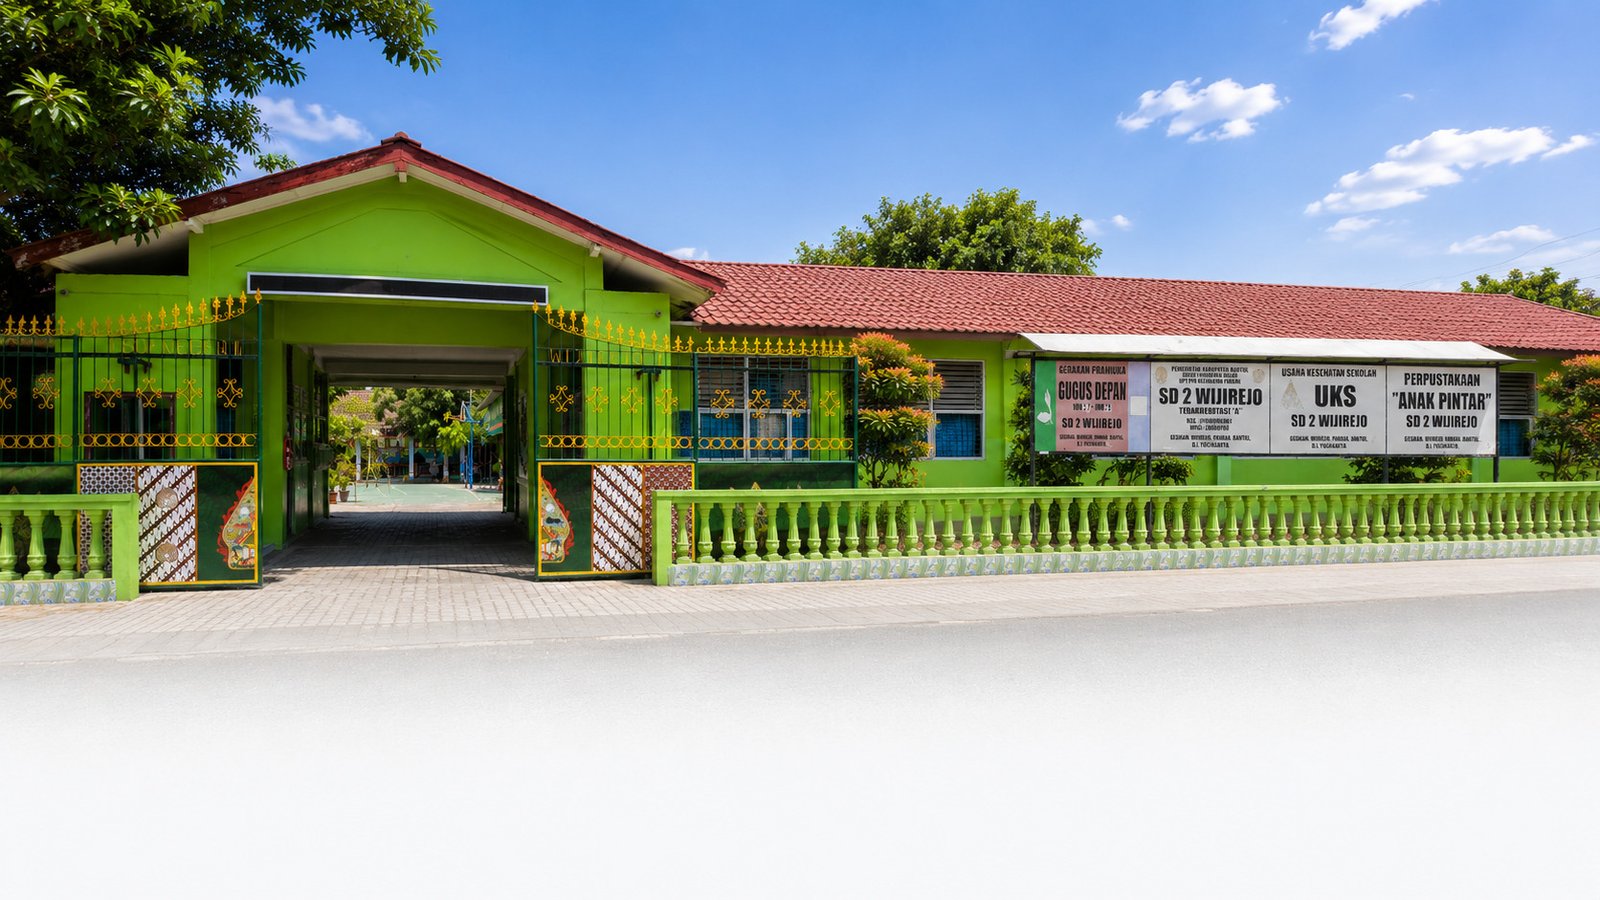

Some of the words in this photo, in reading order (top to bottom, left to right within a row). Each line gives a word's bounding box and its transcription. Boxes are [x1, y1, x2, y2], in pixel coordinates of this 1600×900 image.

[1281, 368, 1306, 377] USAHA
[1306, 368, 1345, 377] KESEHATAN
[1404, 372, 1480, 386] PERPUSTAKAAN
[1058, 381, 1092, 400] GUGUS
[1095, 382, 1126, 401] DEPAN
[1159, 387, 1179, 404] SD
[1182, 387, 1192, 404] 2
[1195, 388, 1263, 406] WIJIREJO
[1315, 384, 1357, 408] UKS
[1075, 418, 1080, 428] 2
[1291, 414, 1306, 427] SD
[1308, 414, 1316, 427] 2
[1318, 414, 1368, 428] WIJIREJO
[1406, 415, 1420, 428] SD
[1423, 415, 1430, 428] 2
[1432, 415, 1478, 428] WIJIREJO
